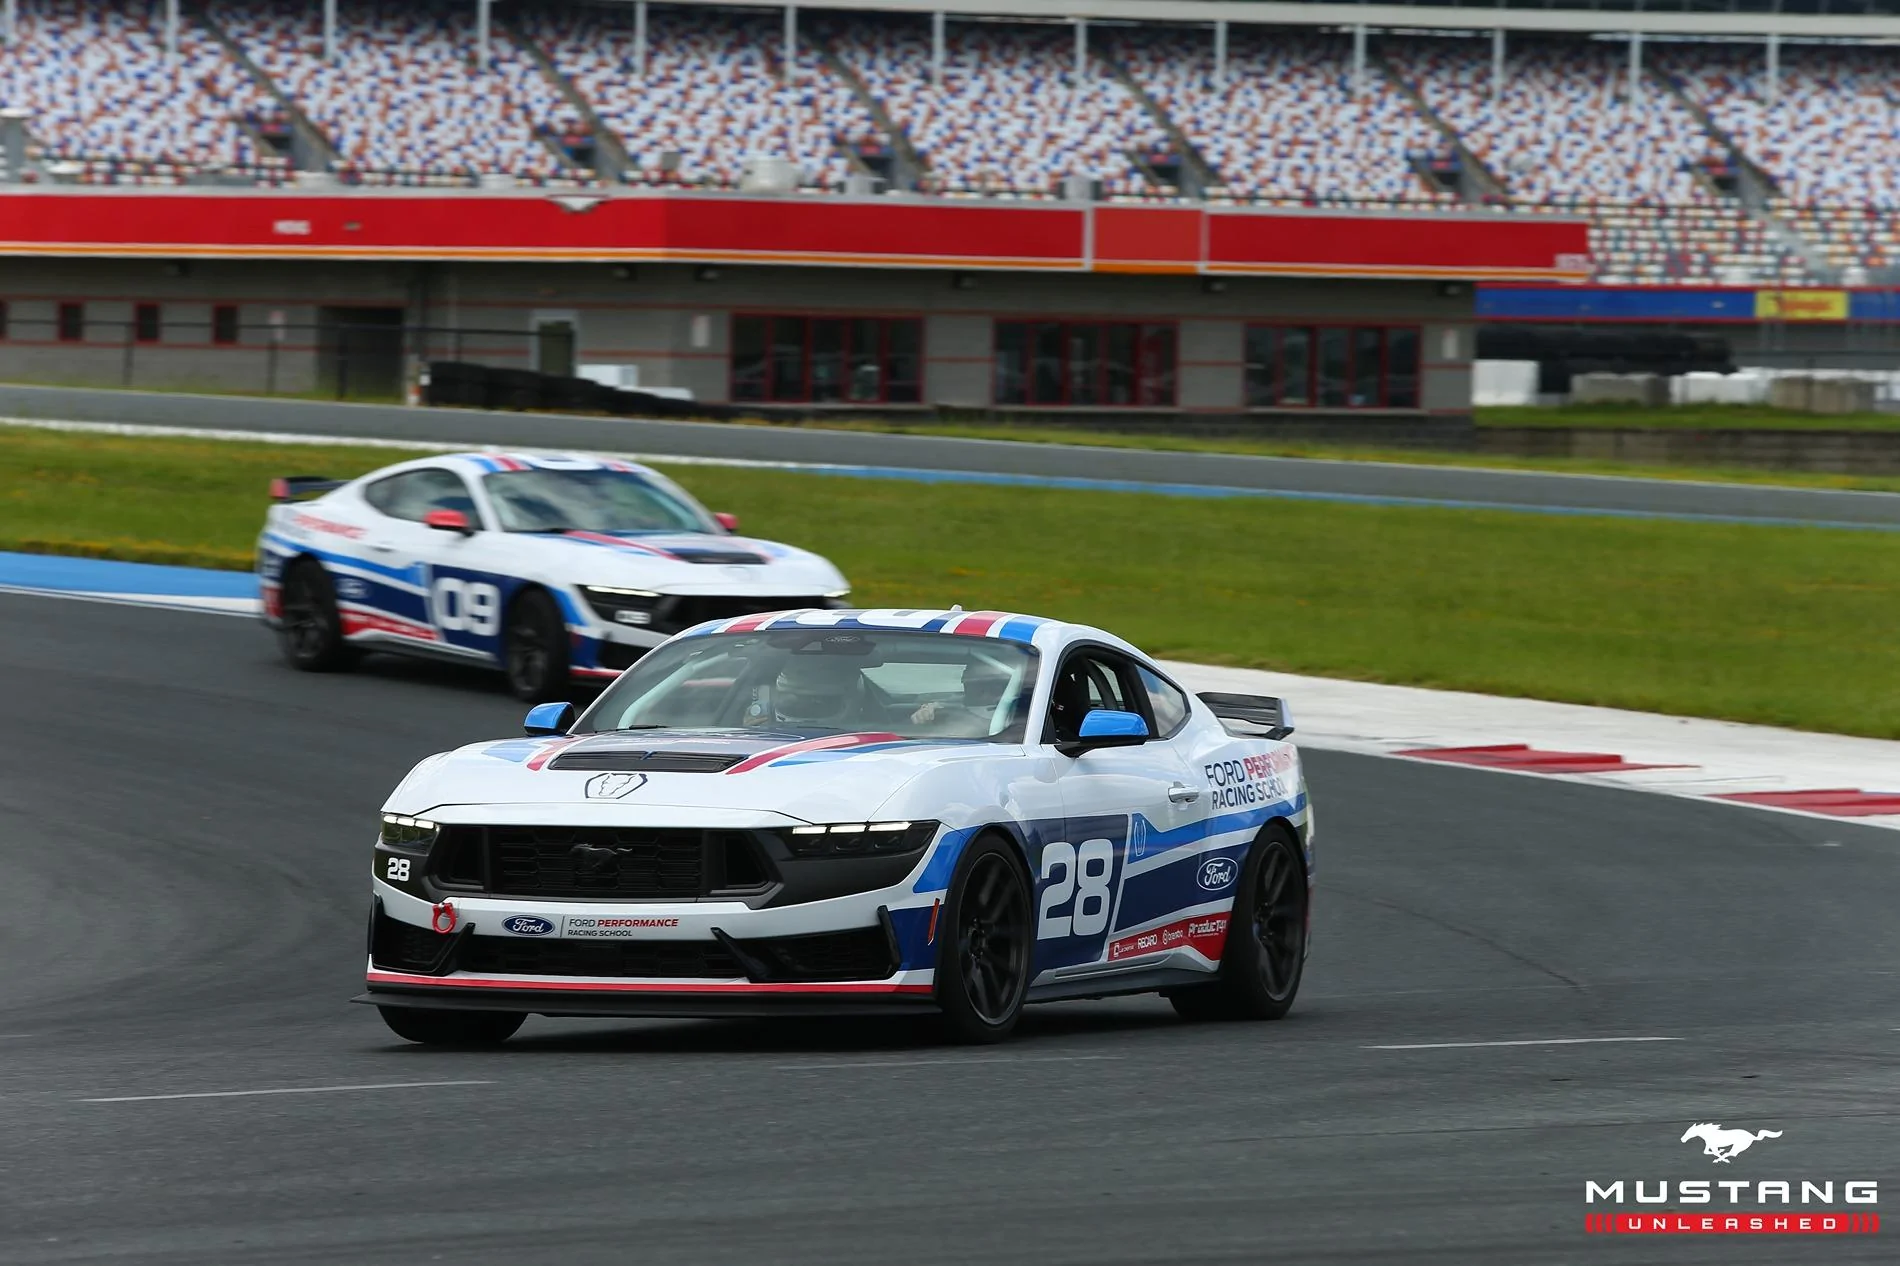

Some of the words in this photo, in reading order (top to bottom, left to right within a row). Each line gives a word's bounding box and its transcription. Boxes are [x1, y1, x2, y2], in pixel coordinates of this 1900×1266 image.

[432, 577, 501, 636] 09
[1204, 758, 1246, 787] FORD
[1212, 784, 1256, 810] RACING
[387, 857, 410, 882] 28
[1204, 862, 1231, 886] Ford
[1037, 838, 1114, 941] 28
[513, 918, 544, 934] Ford
[569, 918, 595, 928] FORD
[597, 918, 679, 928] PERFORMANCE
